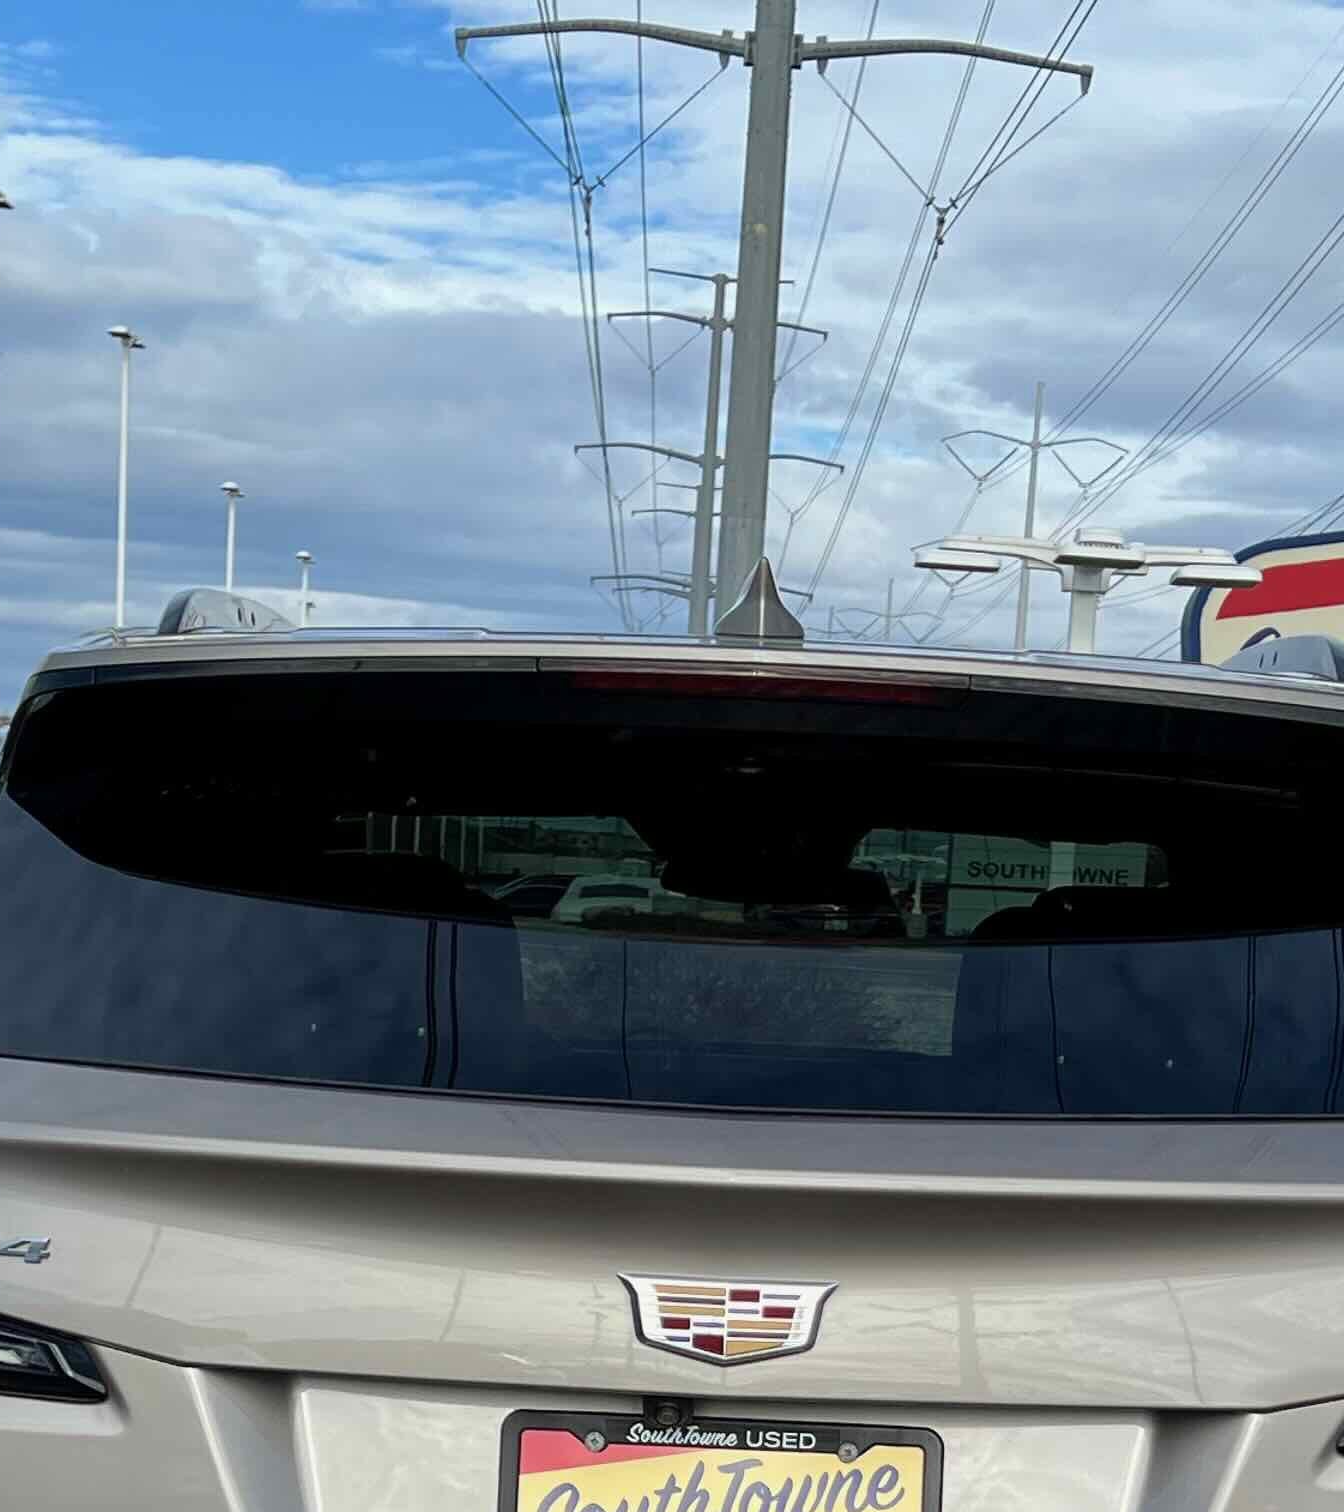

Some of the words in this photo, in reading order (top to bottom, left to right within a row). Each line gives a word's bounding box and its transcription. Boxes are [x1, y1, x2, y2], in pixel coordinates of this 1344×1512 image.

[967, 861, 1130, 885] SOUTHWNE
[626, 1424, 739, 1447] SouthTowne
[746, 1431, 817, 1449] USED
